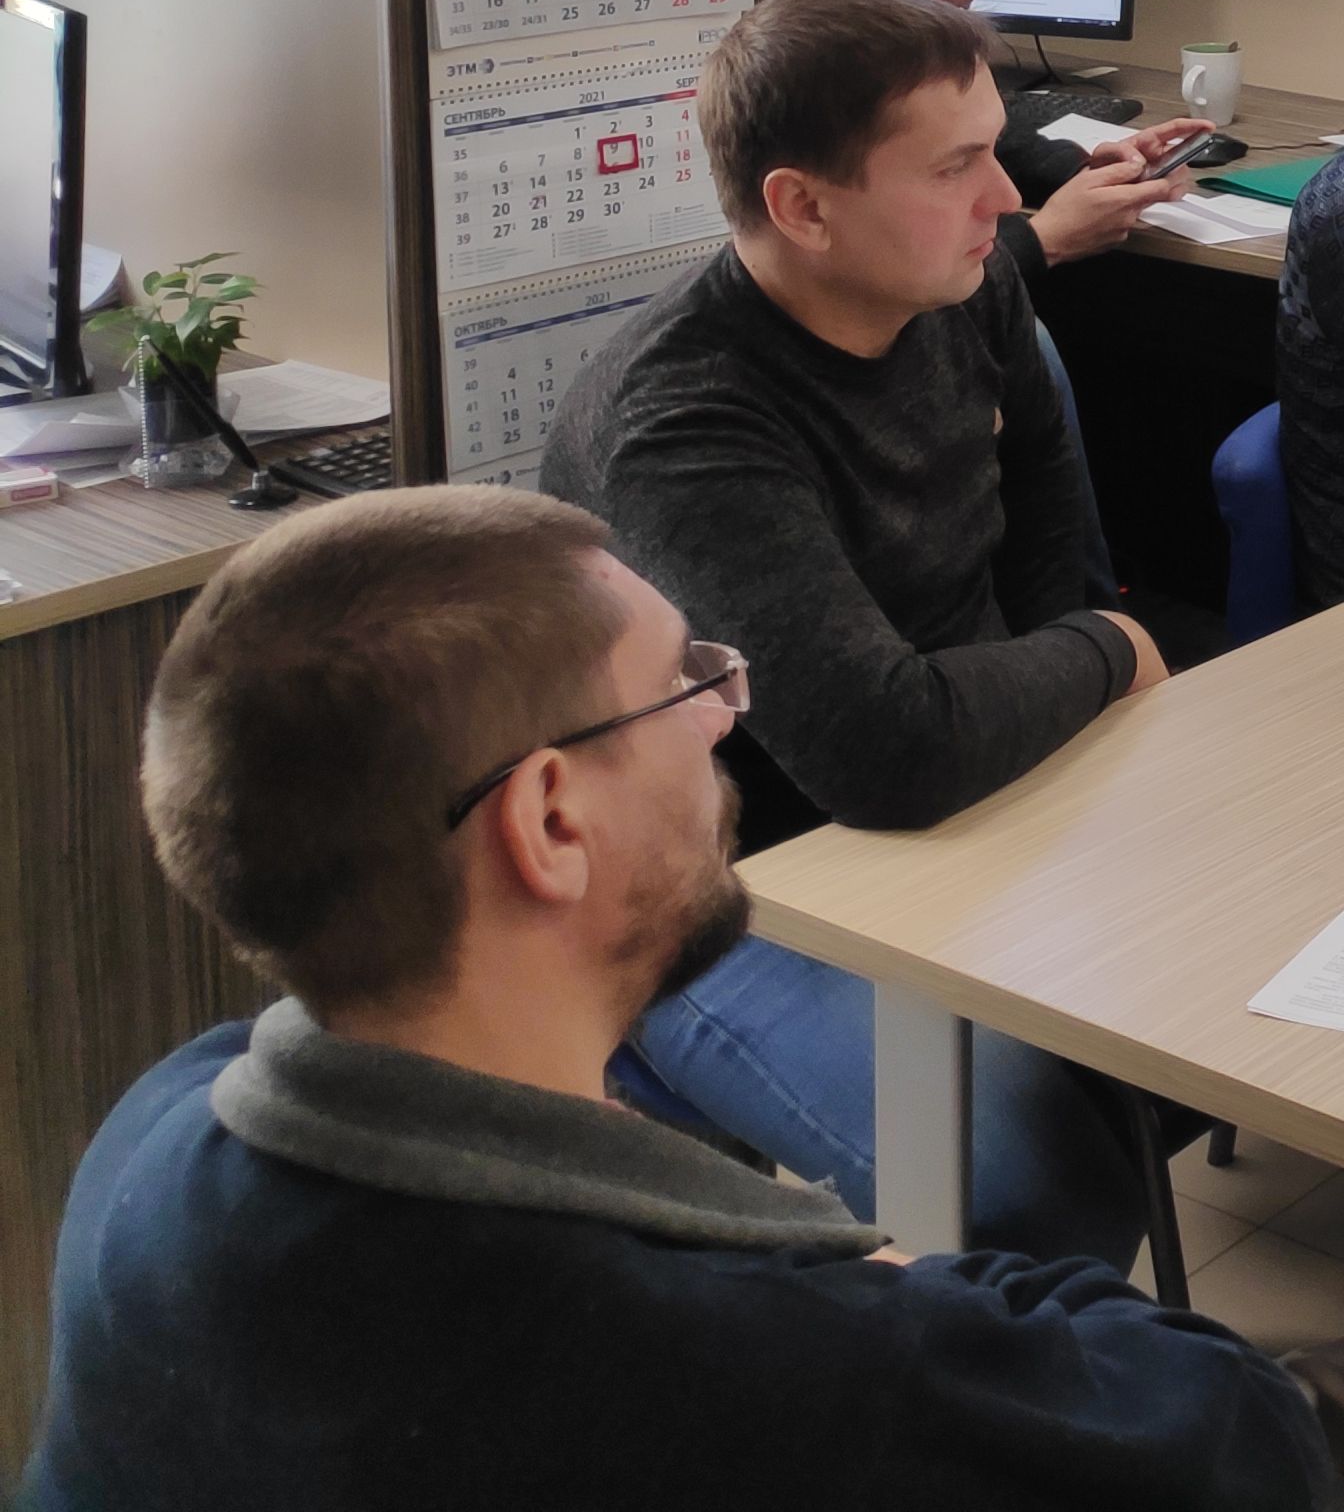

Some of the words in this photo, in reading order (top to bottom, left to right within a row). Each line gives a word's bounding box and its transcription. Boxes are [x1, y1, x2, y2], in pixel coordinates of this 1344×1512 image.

[562, 6, 579, 21] 25
[598, 1, 616, 16] 26
[447, 62, 477, 78] ЭТМ
[579, 91, 605, 105] 2021
[443, 107, 507, 126] СЕНТЯБРЬ
[574, 127, 581, 139] 1
[609, 121, 618, 134] 2
[645, 115, 653, 128] 3
[681, 109, 690, 121] 4
[498, 160, 509, 174] 6
[537, 153, 546, 167] 7
[573, 147, 583, 161] 8
[676, 129, 690, 143] 11
[492, 181, 510, 196] 13
[529, 175, 547, 189] 14
[566, 168, 583, 182] 15
[675, 148, 691, 163] 18
[492, 202, 511, 218] 20
[566, 188, 584, 203] 22
[603, 181, 620, 197] 23
[638, 175, 656, 190] 24
[676, 168, 692, 183] 25
[493, 223, 512, 239] 27
[531, 215, 549, 231] 28
[567, 208, 585, 224] 29
[604, 201, 621, 217] 30
[585, 291, 612, 307] 2021
[454, 316, 508, 338] ОКТЯБРЬ
[507, 367, 517, 380] 4
[545, 357, 553, 372] 5
[501, 388, 517, 404] 11
[537, 378, 554, 393] 12
[502, 408, 520, 424] 18
[538, 398, 555, 414] 19
[503, 428, 521, 445] 25
